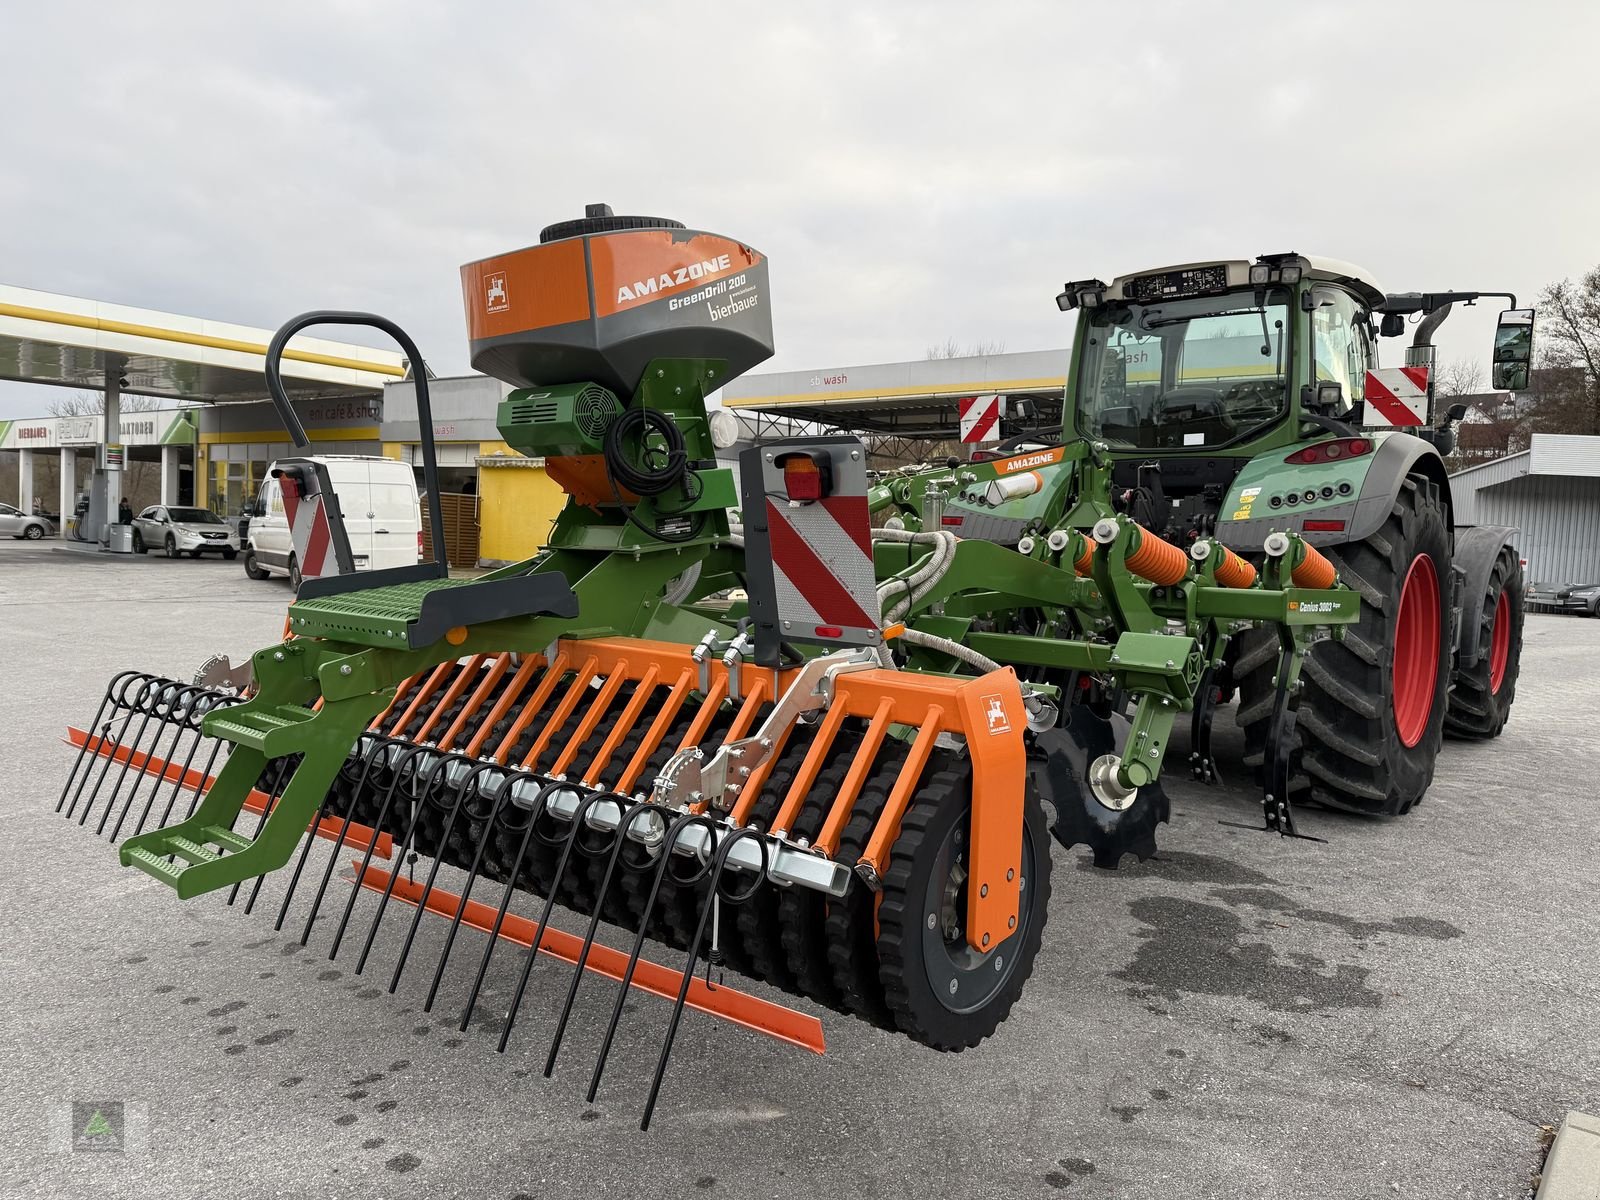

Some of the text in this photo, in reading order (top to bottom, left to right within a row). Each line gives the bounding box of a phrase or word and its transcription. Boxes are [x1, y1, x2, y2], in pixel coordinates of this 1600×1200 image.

[617, 254, 731, 304] AMAZONE
[669, 274, 746, 311] GreenDrill 200
[707, 292, 758, 322] bierbauer
[1126, 350, 1148, 364] ash
[823, 373, 848, 385] wash
[1006, 452, 1054, 471] AMAZONE
